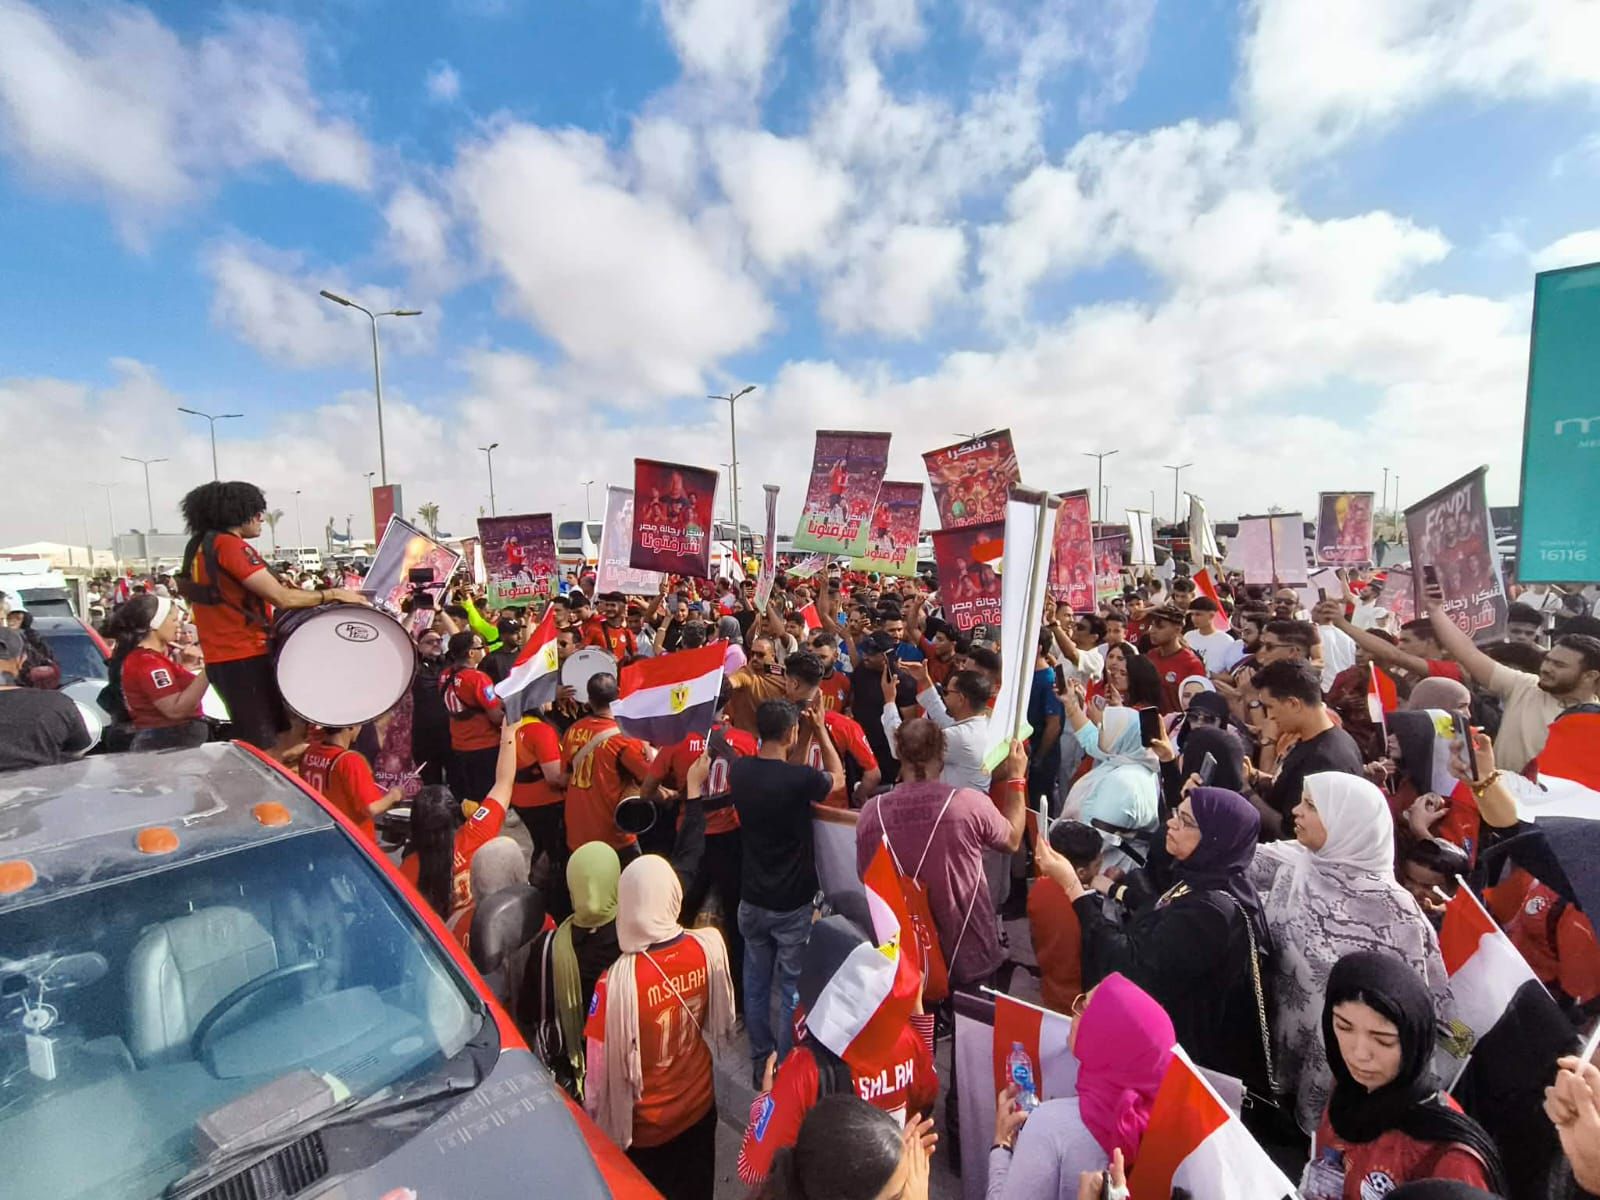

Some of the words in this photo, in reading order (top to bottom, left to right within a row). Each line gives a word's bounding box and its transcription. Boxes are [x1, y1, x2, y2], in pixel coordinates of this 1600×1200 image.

[947, 439, 987, 460] شكرا
[639, 522, 658, 535] مصر
[660, 524, 680, 537] رجالة
[641, 532, 701, 557] شرفتونا
[1540, 549, 1588, 562] 16116
[951, 601, 973, 614] مصر
[647, 967, 706, 1008] M.SALAH
